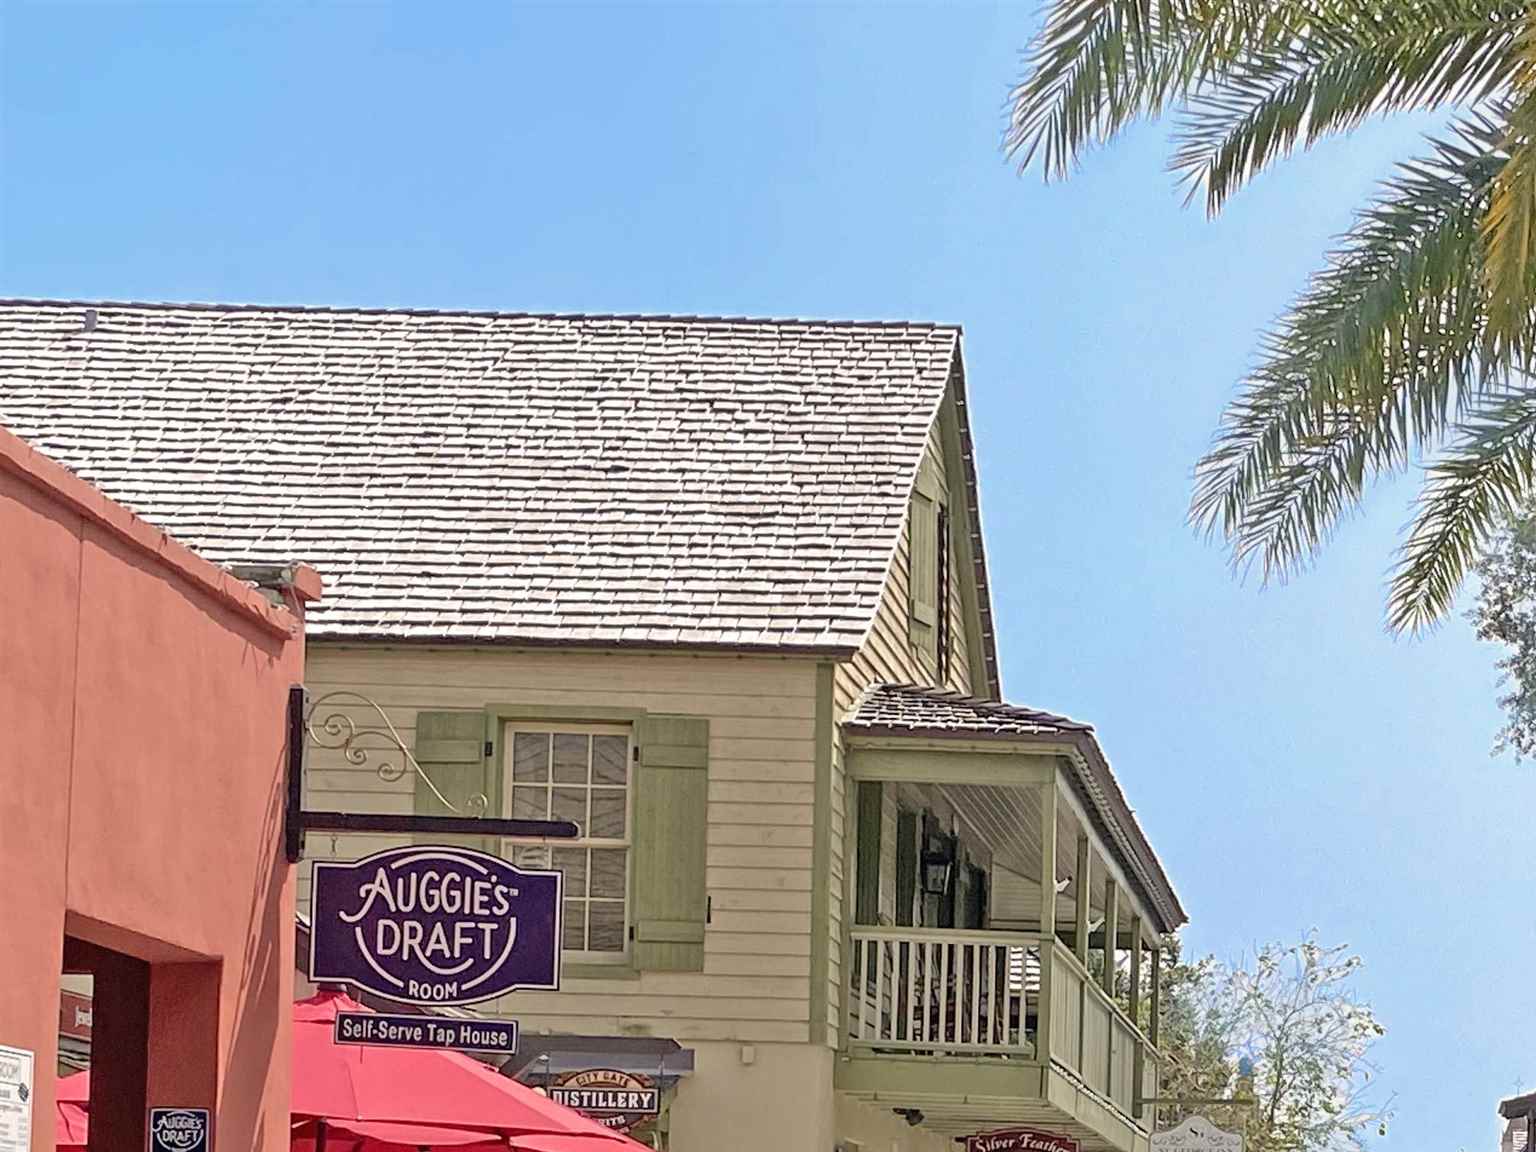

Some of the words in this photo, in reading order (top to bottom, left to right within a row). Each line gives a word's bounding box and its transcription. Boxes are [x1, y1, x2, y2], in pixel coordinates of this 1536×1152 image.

[376, 919, 499, 972] DRAFT
[408, 980, 458, 999] ROOM
[342, 1019, 422, 1041] Self-Serve
[427, 1024, 456, 1044] Tap
[460, 1028, 508, 1046] House
[552, 1090, 653, 1108] DISTILLERY
[162, 1129, 198, 1144] DRAFT
